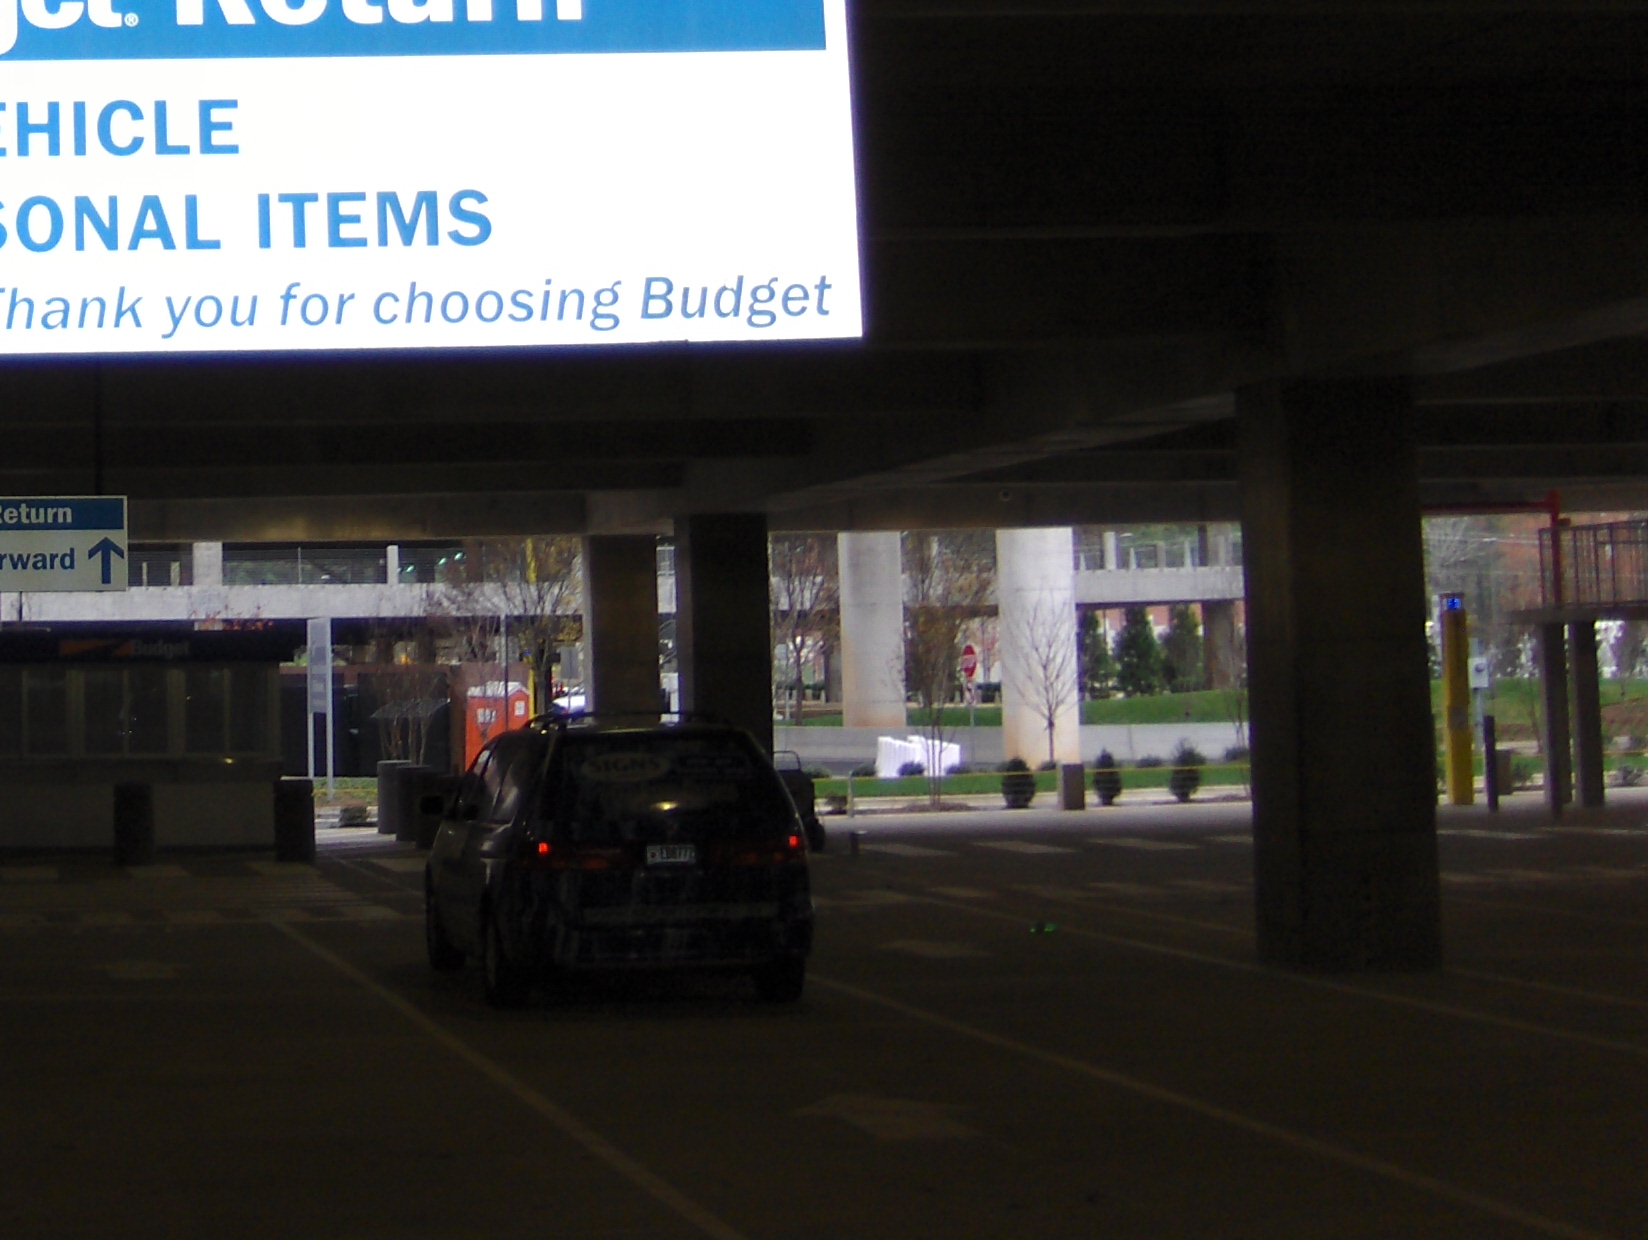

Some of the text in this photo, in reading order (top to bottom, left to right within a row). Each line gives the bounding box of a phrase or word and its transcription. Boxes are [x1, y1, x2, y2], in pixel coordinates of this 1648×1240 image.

[258, 190, 491, 248] ITEMS
[162, 296, 257, 339] you
[280, 282, 355, 326] for
[374, 279, 621, 331] choosing
[641, 276, 831, 328] Budget
[132, 639, 190, 659] Budget
